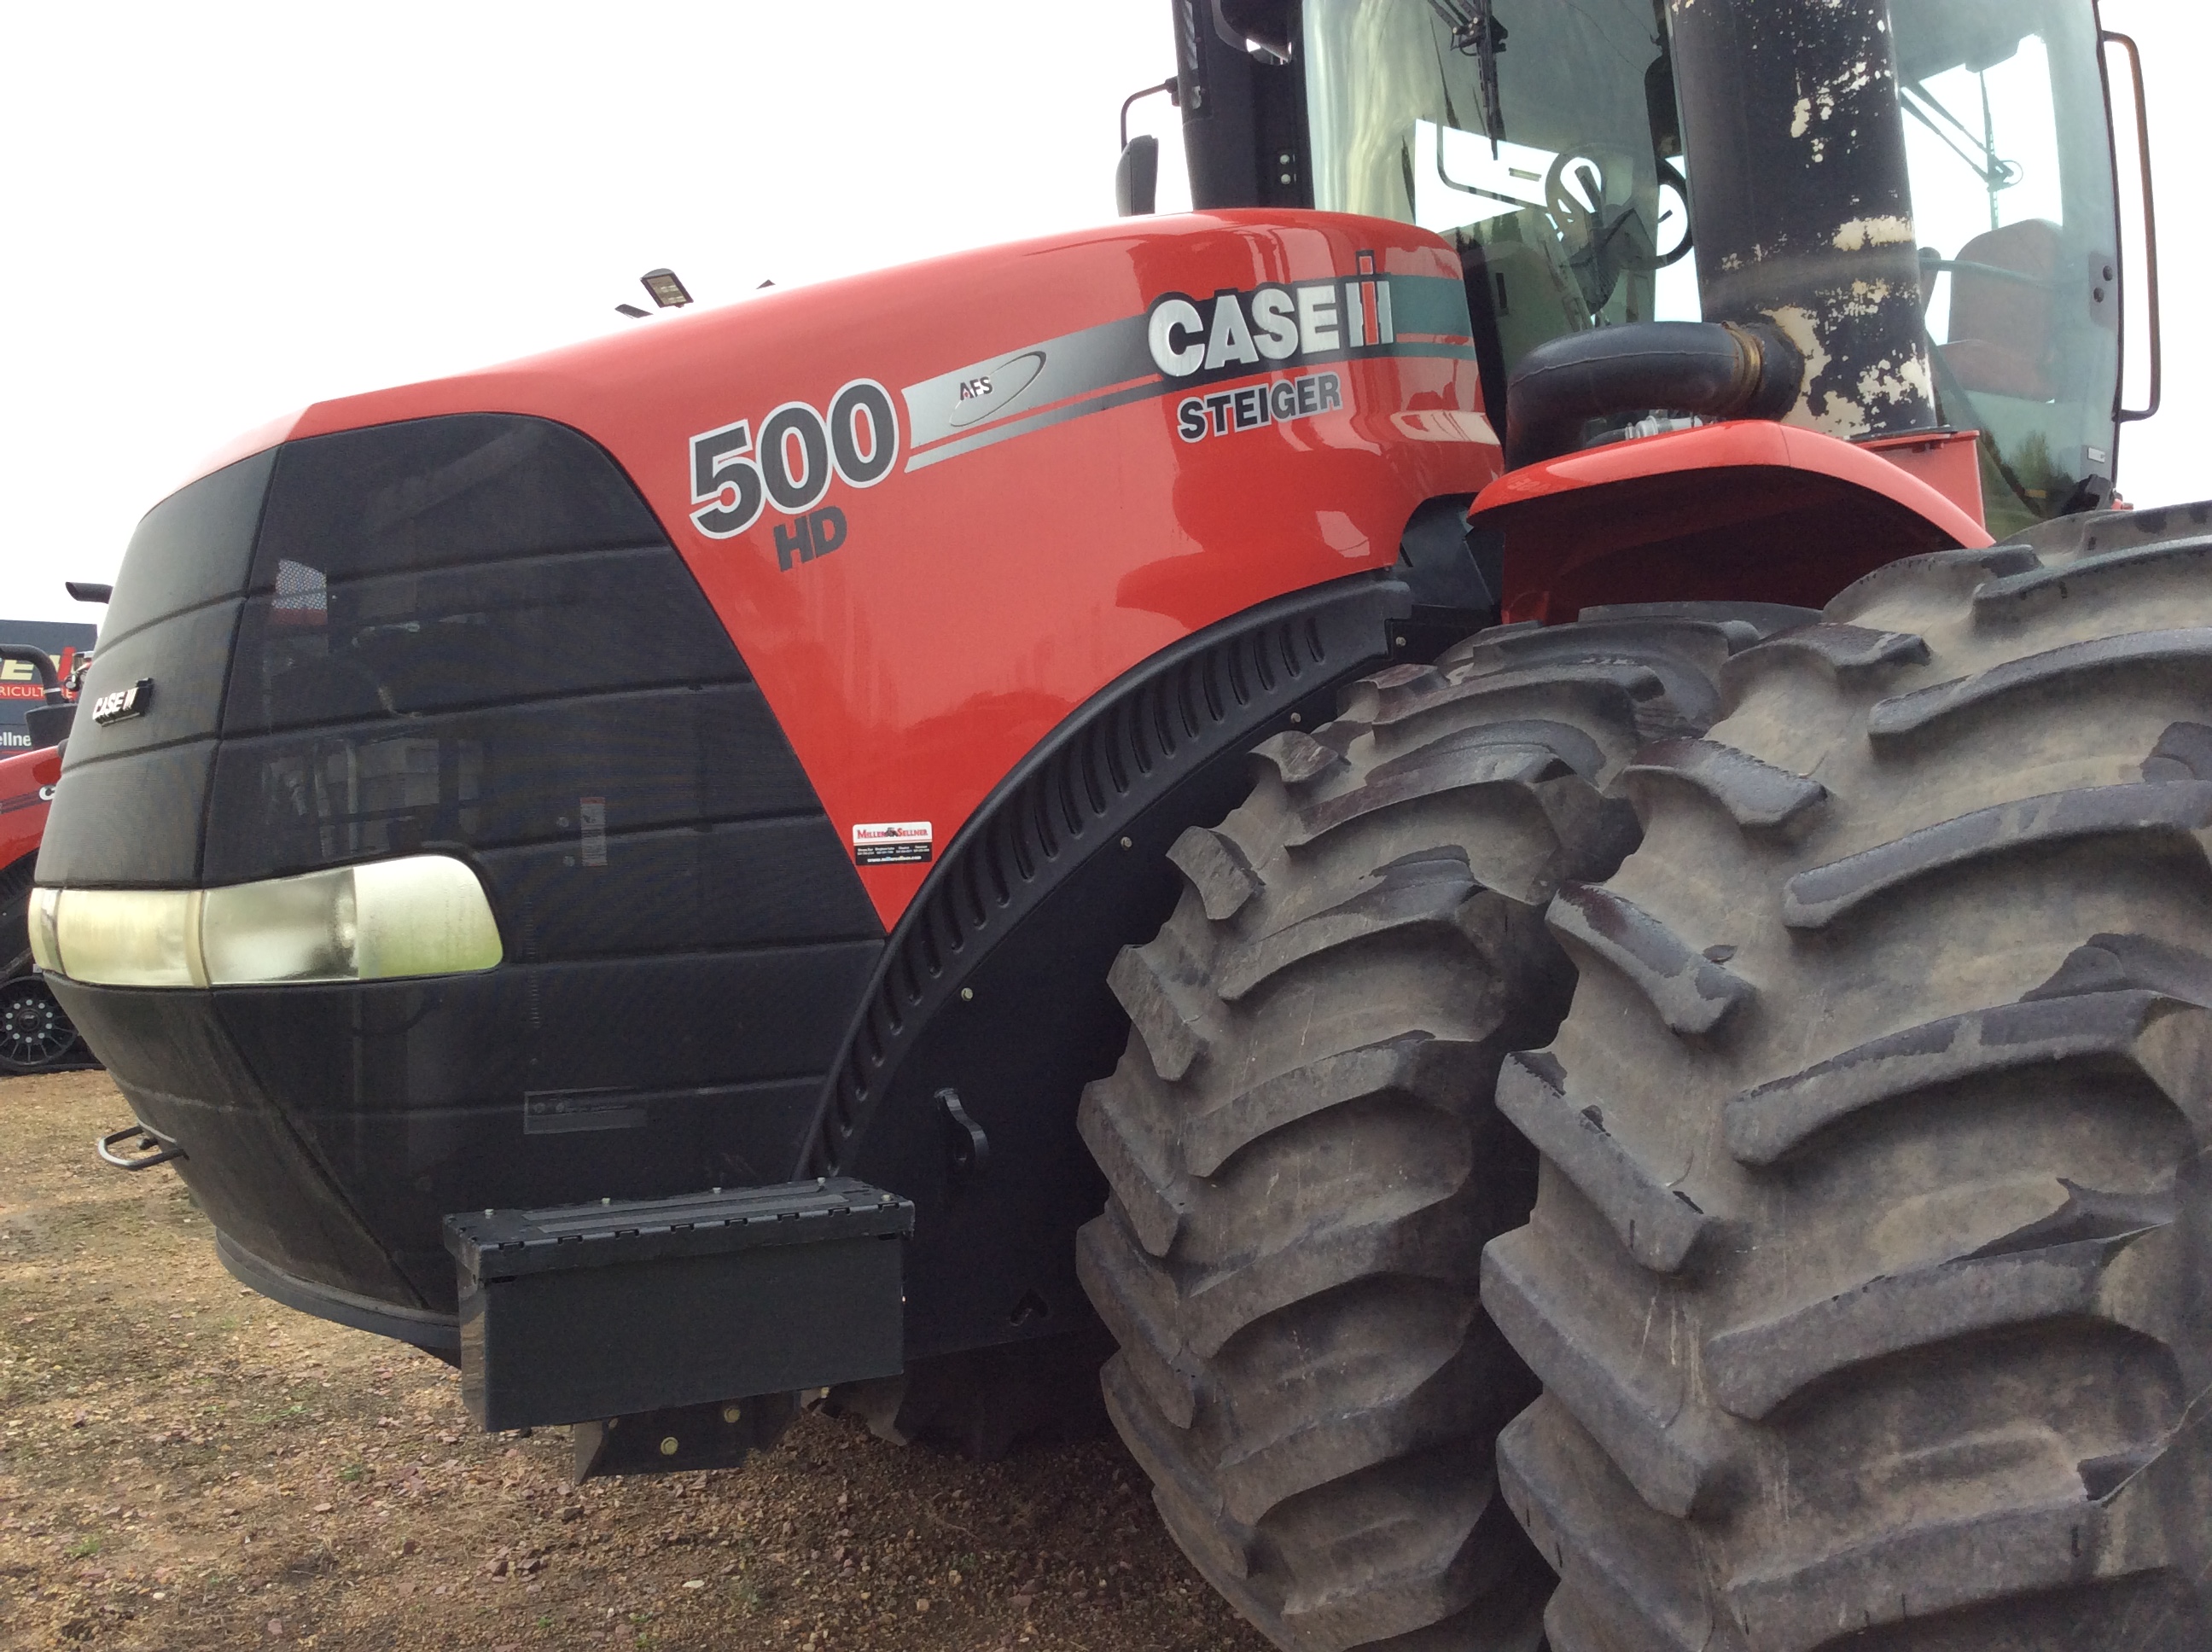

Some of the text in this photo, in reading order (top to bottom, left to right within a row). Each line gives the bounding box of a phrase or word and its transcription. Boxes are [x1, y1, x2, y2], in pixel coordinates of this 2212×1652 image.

[1148, 284, 1341, 377] CASE
[959, 375, 993, 401] AFS
[1177, 370, 1343, 443] STEIGER
[689, 377, 899, 540] 500
[772, 504, 848, 573] HD
